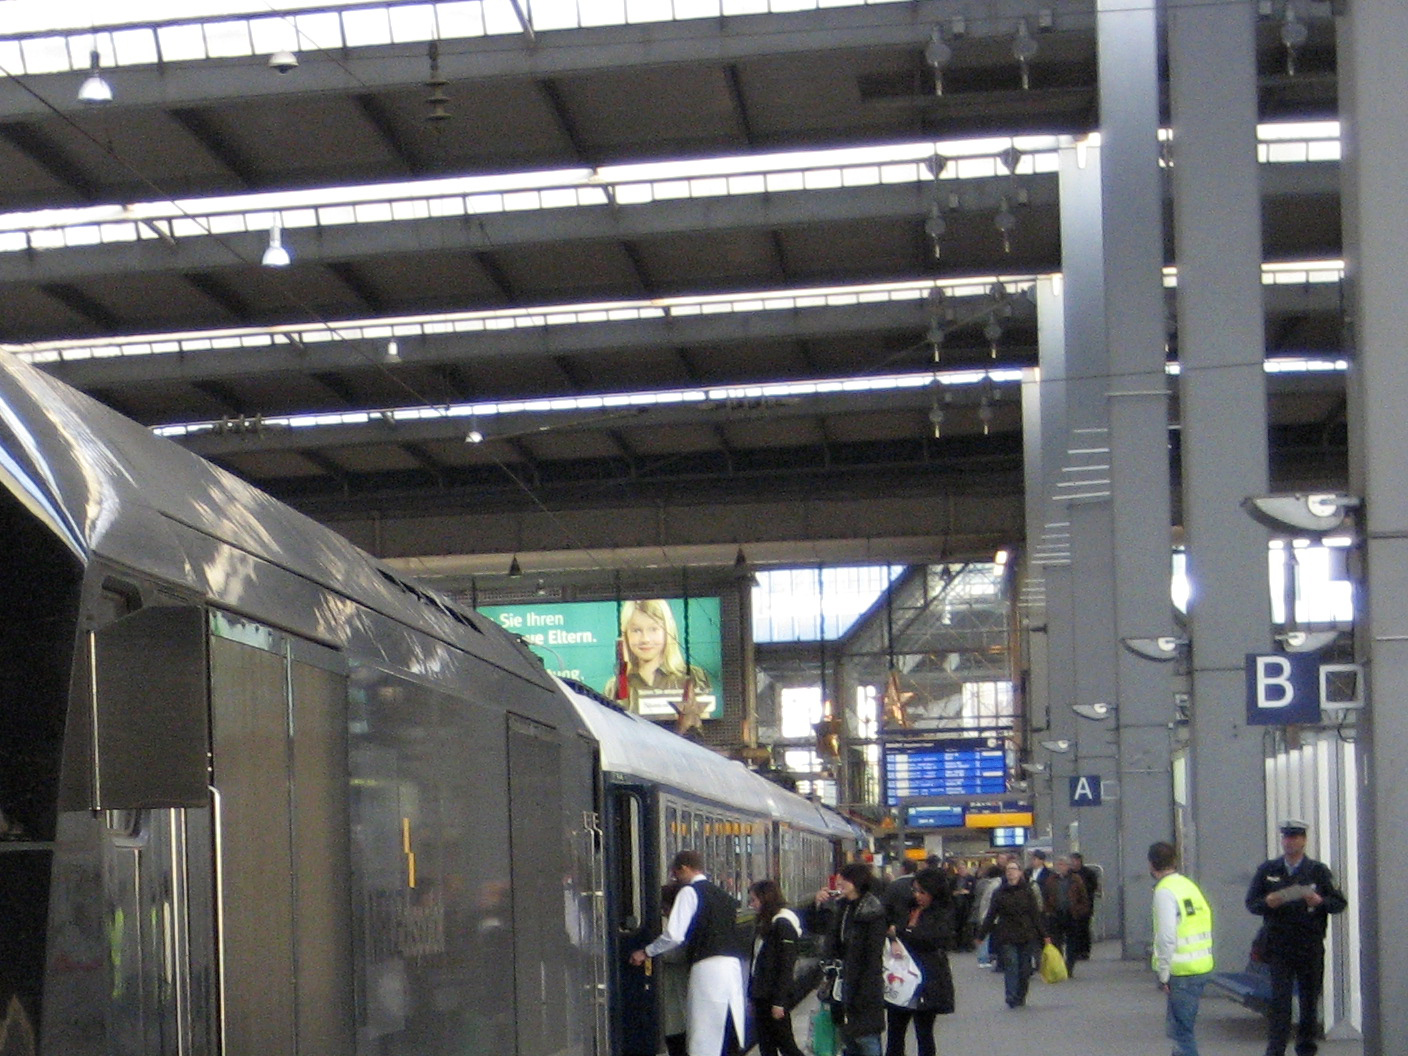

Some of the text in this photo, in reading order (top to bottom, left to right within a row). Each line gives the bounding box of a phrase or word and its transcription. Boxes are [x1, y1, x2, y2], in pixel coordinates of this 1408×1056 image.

[499, 611, 564, 628] Sie Ihren
[548, 629, 597, 645] Eltern.
[1256, 656, 1294, 708] B
[1074, 777, 1093, 801] A
